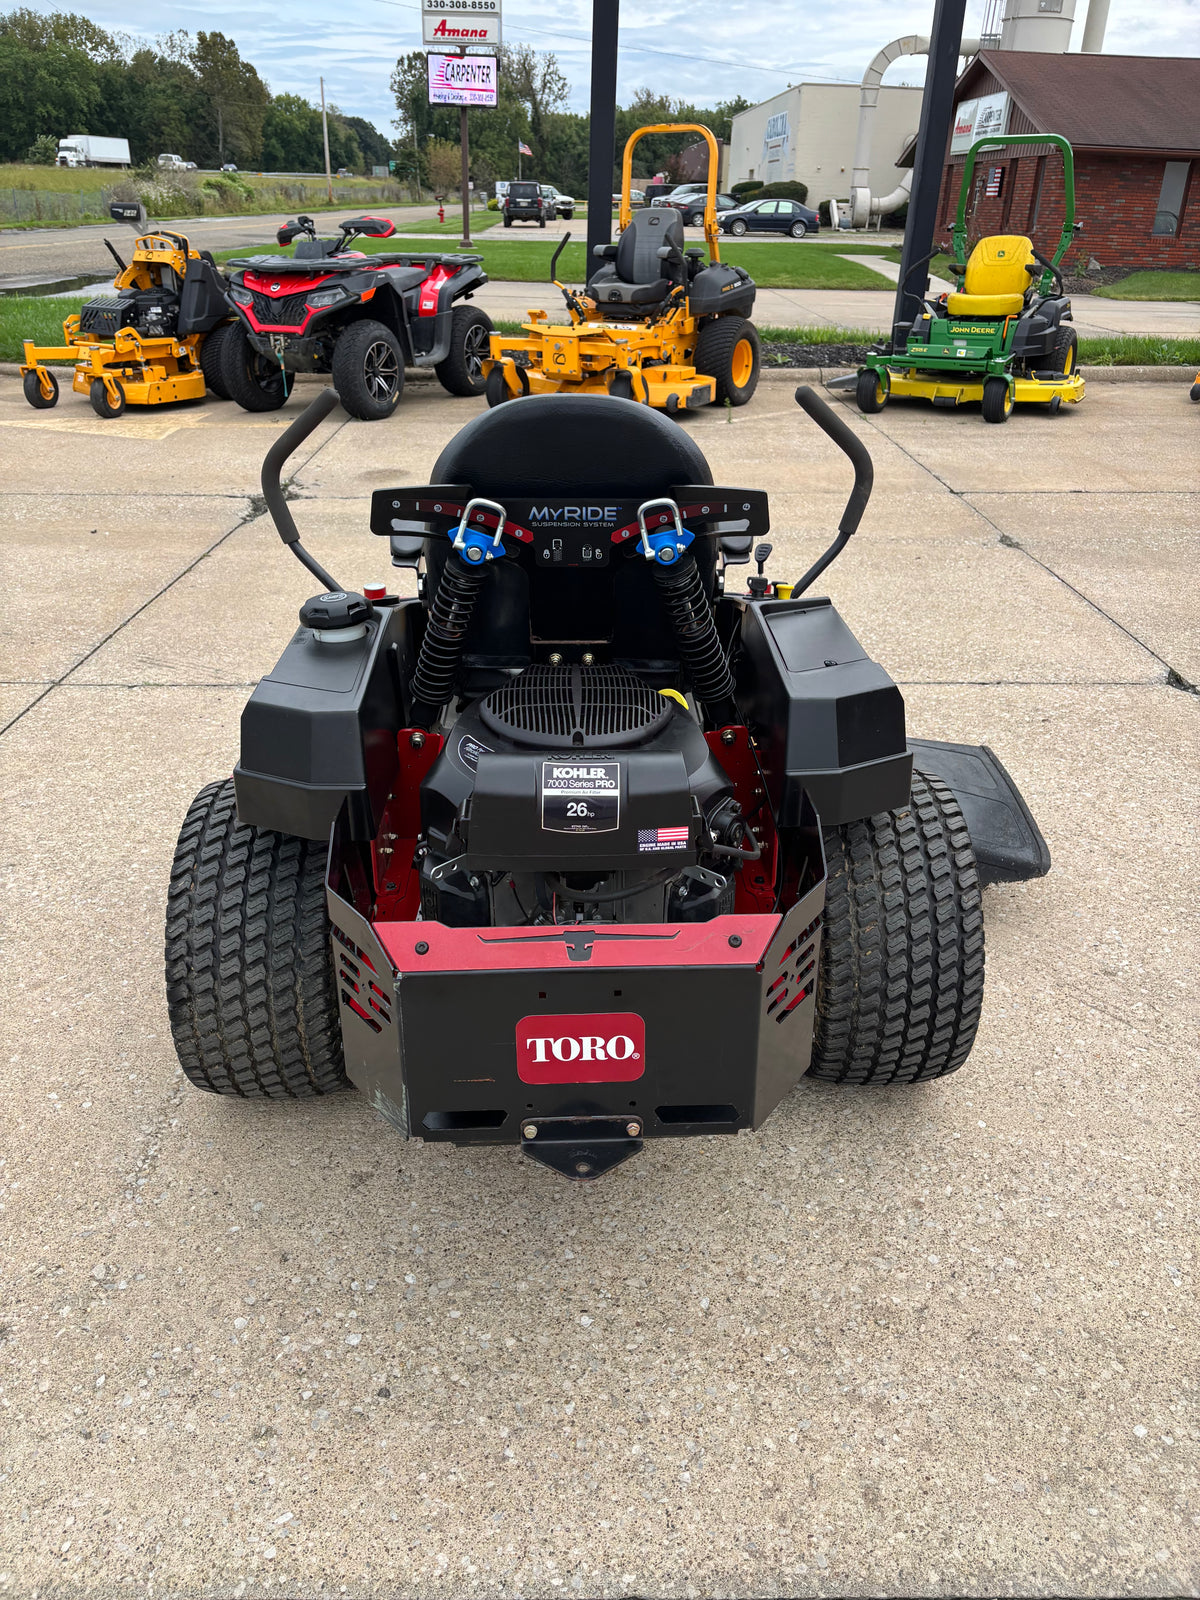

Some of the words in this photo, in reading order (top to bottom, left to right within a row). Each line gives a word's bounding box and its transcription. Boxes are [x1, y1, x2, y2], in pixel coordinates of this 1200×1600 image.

[433, 19, 488, 37] Amana
[445, 63, 491, 83] CARPENTER
[970, 326, 996, 334] DEERE
[547, 779, 568, 788] 7000
[568, 779, 595, 788] Series
[595, 780, 616, 788] PRO
[566, 802, 588, 817] 26
